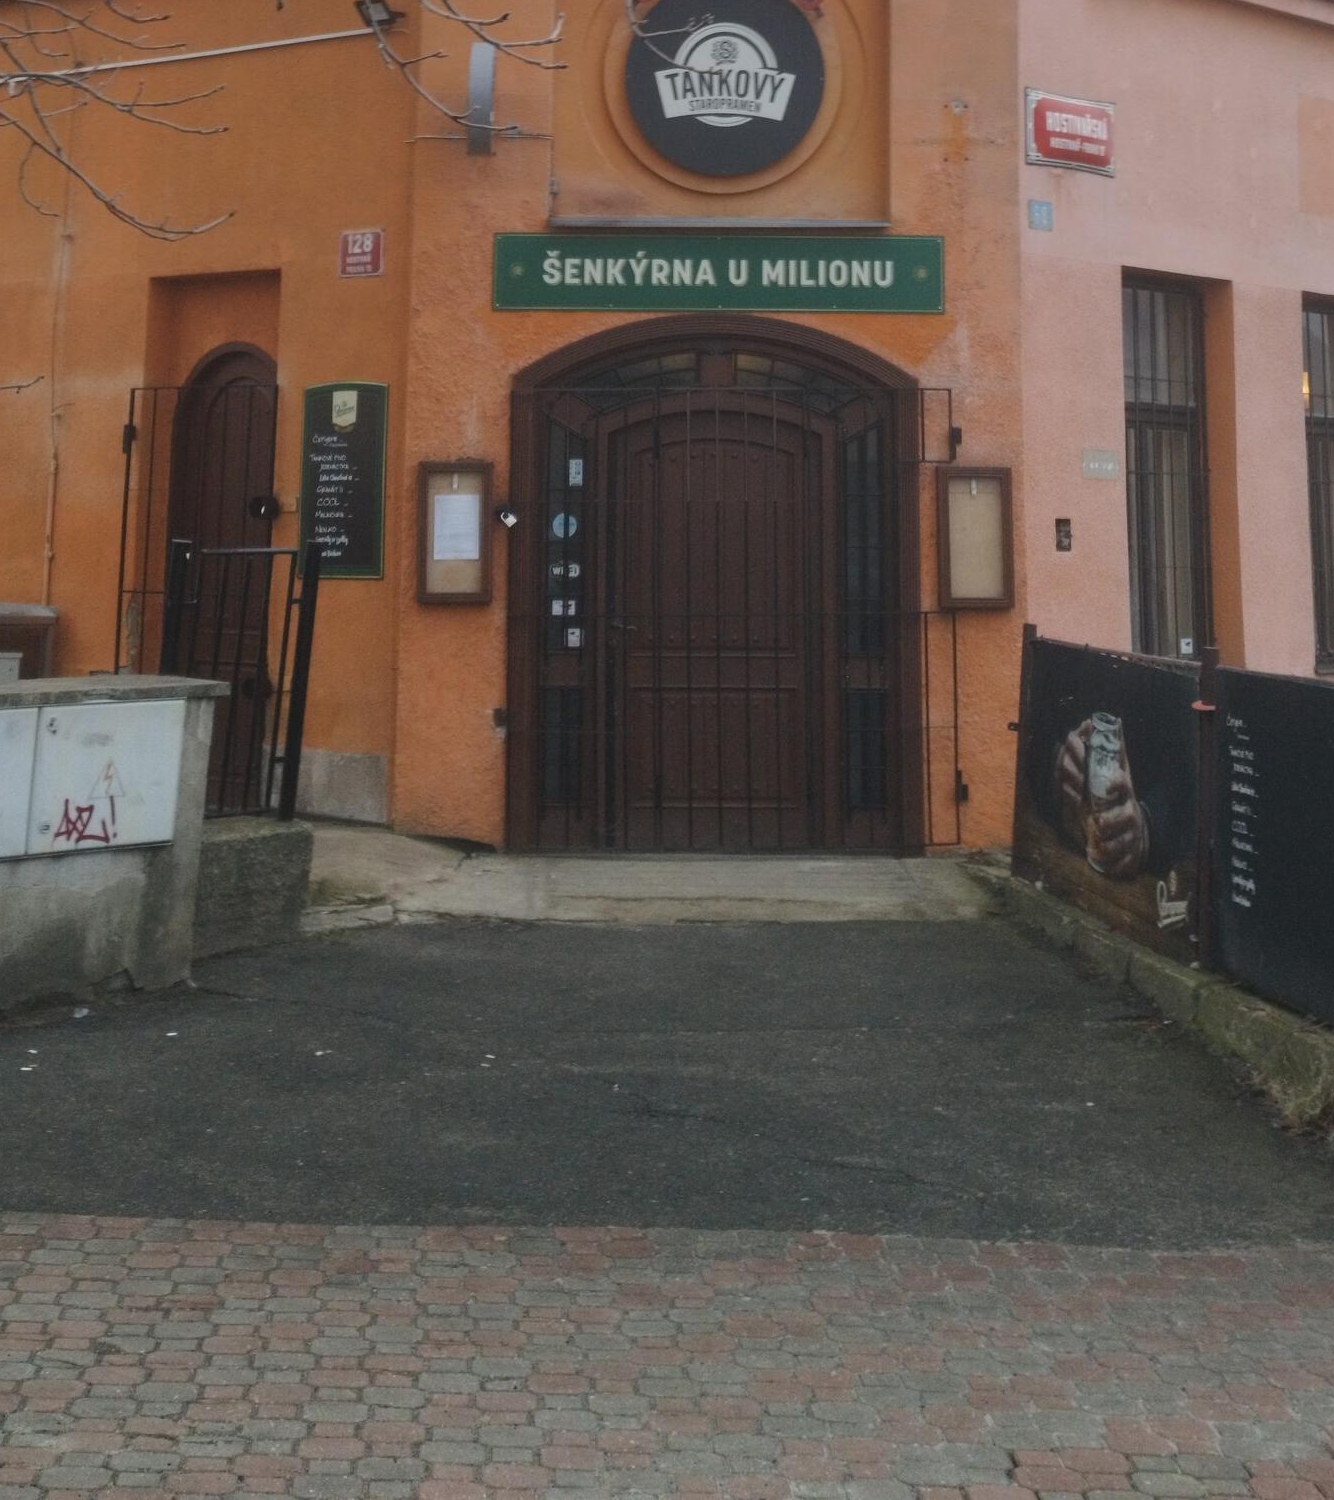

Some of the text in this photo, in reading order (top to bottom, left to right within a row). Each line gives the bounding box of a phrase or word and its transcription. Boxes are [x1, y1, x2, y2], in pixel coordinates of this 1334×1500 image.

[688, 97, 762, 113] STAROPRAMEN
[347, 233, 374, 254] 128
[541, 250, 894, 288] ŠENKÝRNA U MILIONU
